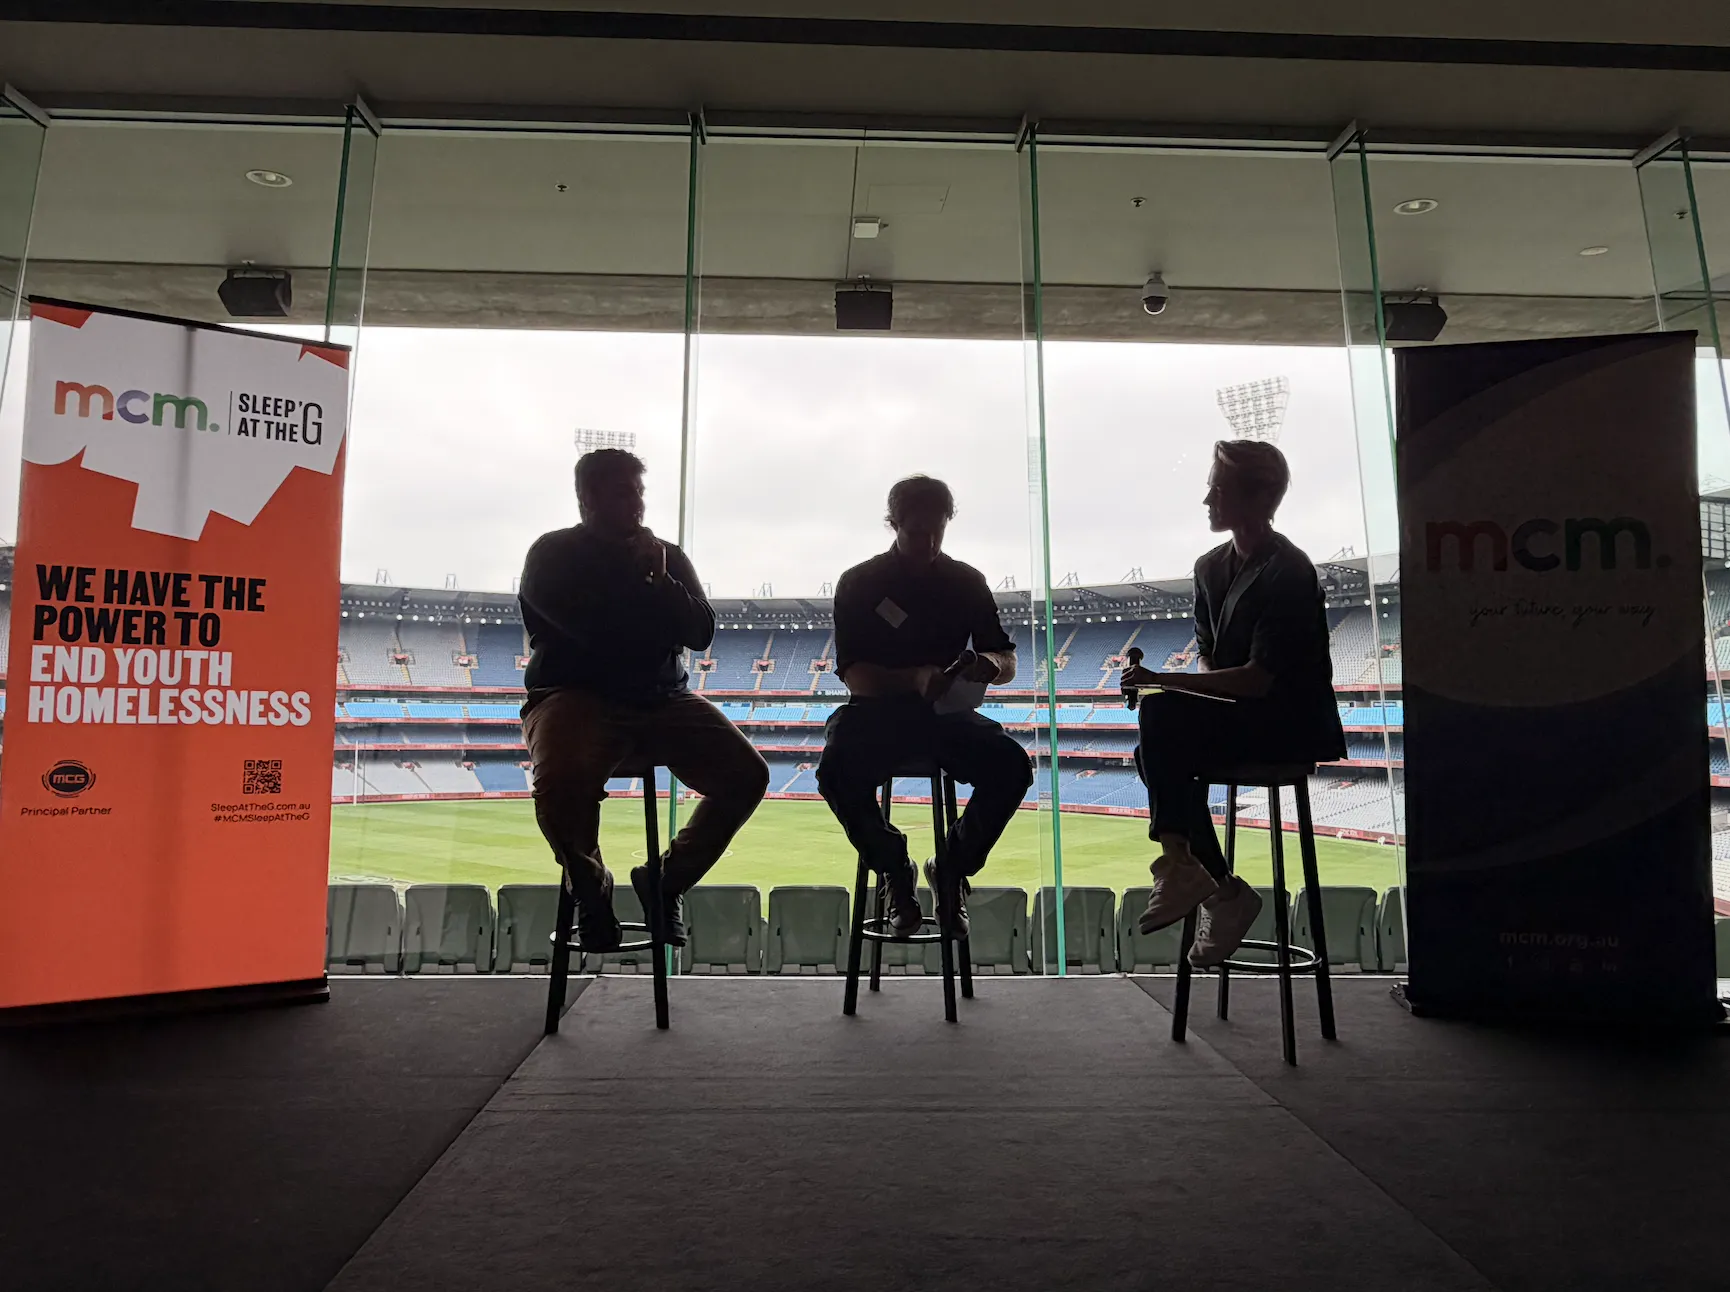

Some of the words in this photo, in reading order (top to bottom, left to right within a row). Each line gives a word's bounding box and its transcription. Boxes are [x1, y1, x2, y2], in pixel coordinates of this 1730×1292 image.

[54, 380, 220, 433] mcm.
[237, 417, 260, 438] AT
[264, 420, 299, 443] THE
[302, 402, 323, 446] G
[1426, 516, 1672, 572] mcm.
[36, 564, 96, 603] WE
[103, 568, 192, 608] HAVE
[198, 574, 266, 612] THE
[33, 604, 166, 646] POWER
[173, 610, 220, 647] TO
[1469, 604, 1507, 627] your
[1571, 605, 1612, 627] your
[1617, 605, 1657, 627] way
[29, 644, 106, 684] END
[112, 647, 233, 687] YOUTH
[27, 685, 311, 727] HOMELESSNESS
[20, 807, 69, 817] Principal
[71, 806, 112, 815] Partner
[211, 803, 311, 812] SleepAtTheG.com.au
[214, 812, 310, 823] #MCMSleepAtTheG
[1500, 932, 1619, 949] mcm.org.au
